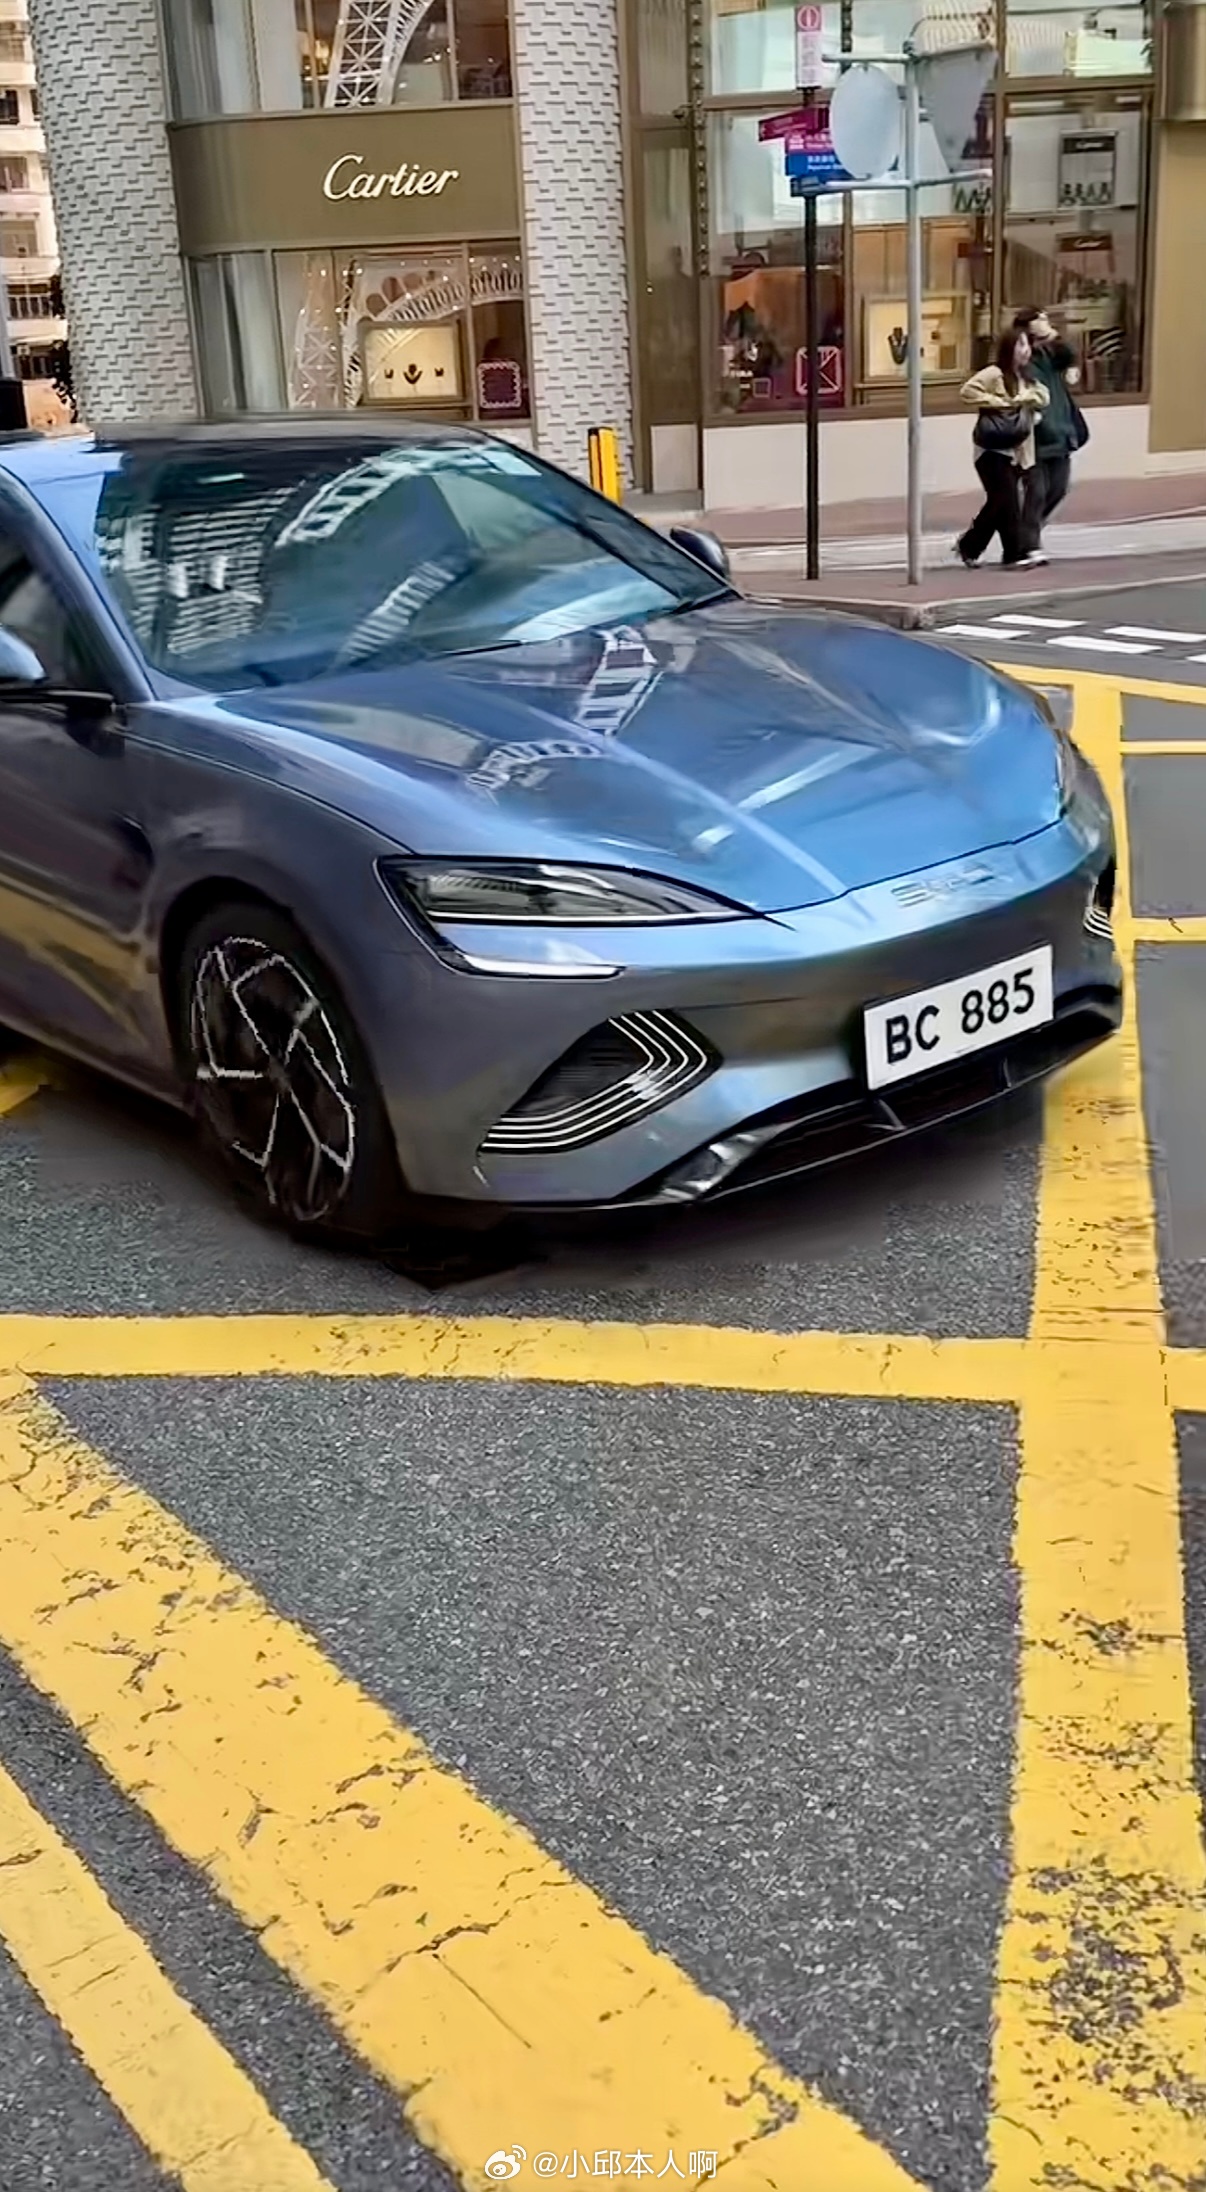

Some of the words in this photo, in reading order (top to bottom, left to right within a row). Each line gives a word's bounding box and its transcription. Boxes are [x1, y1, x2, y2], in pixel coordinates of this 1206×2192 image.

[323, 153, 460, 201] Cartier
[885, 1004, 940, 1065] BC
[960, 967, 1036, 1035] 885
